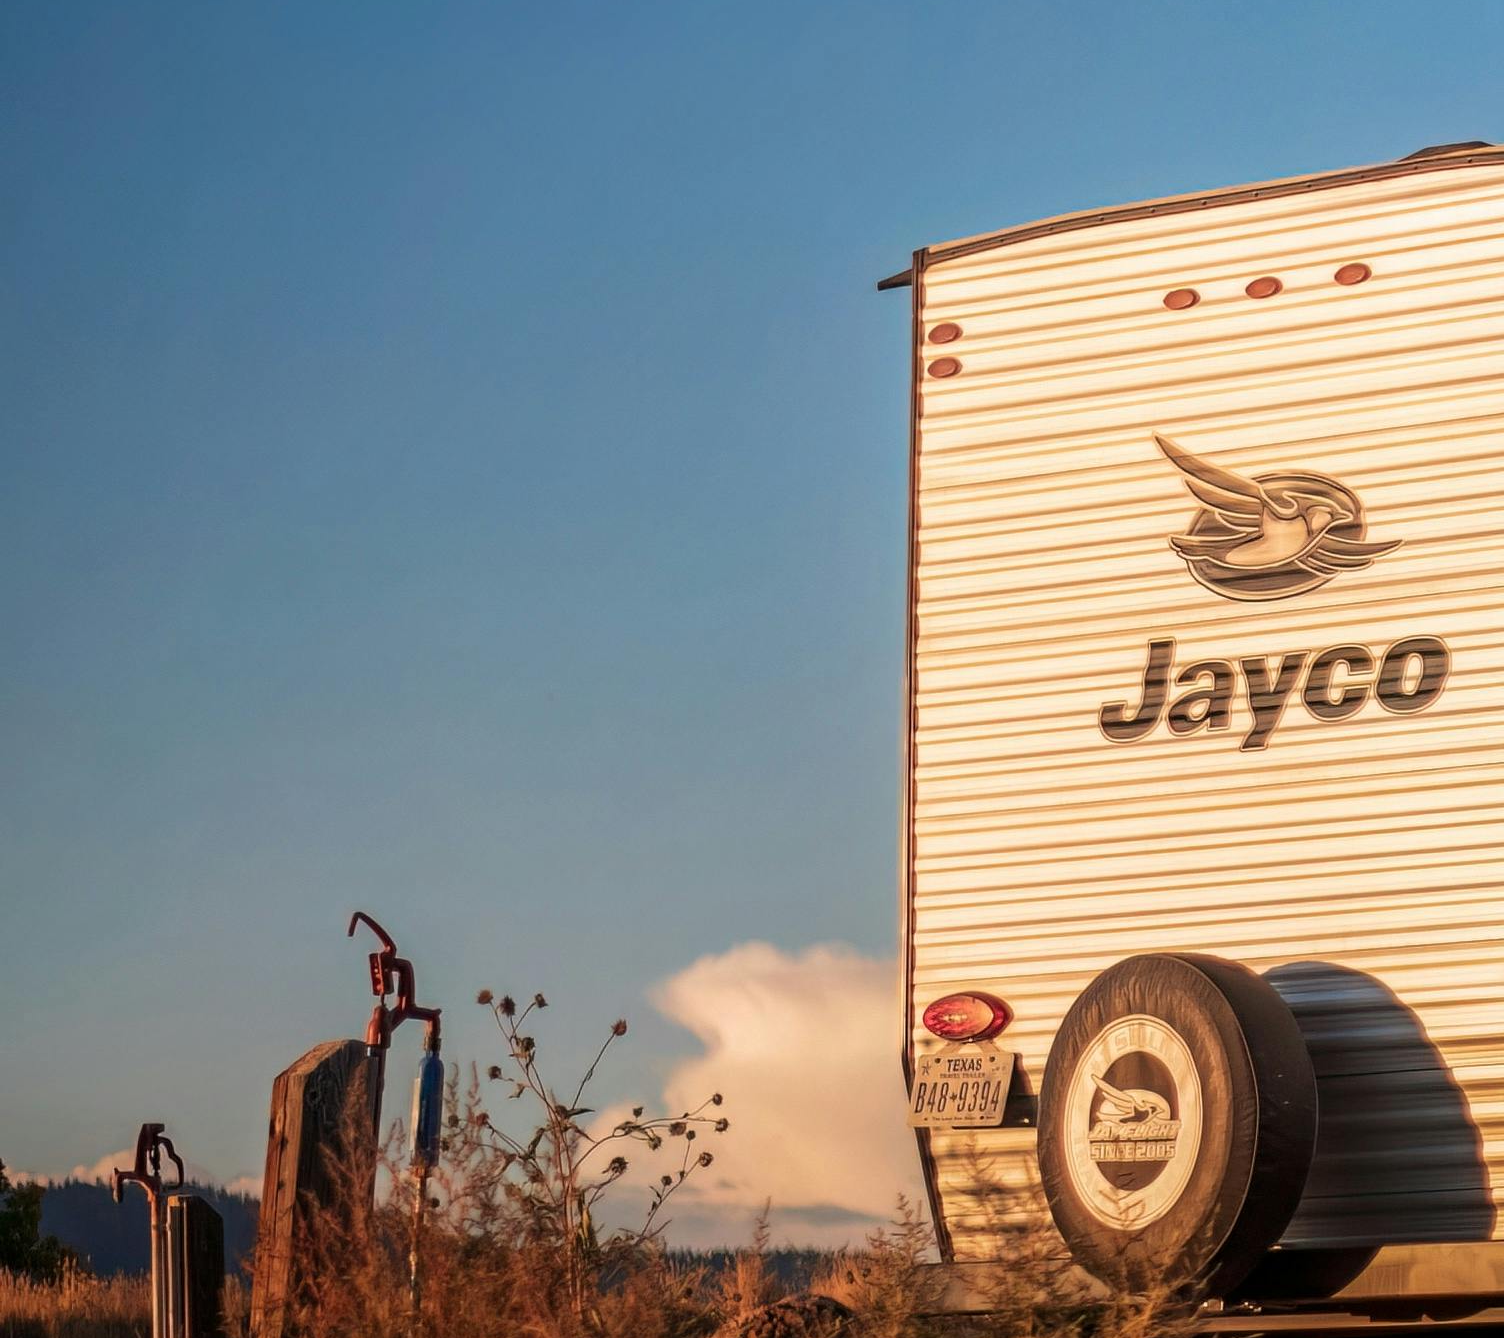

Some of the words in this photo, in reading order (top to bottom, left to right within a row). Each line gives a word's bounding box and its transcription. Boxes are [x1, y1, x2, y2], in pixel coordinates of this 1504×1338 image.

[1098, 635, 1452, 752] Jayco
[947, 1058, 982, 1072] TEXAS
[1090, 1142, 1135, 1160] SINCE
[1136, 1141, 1176, 1160] 2005
